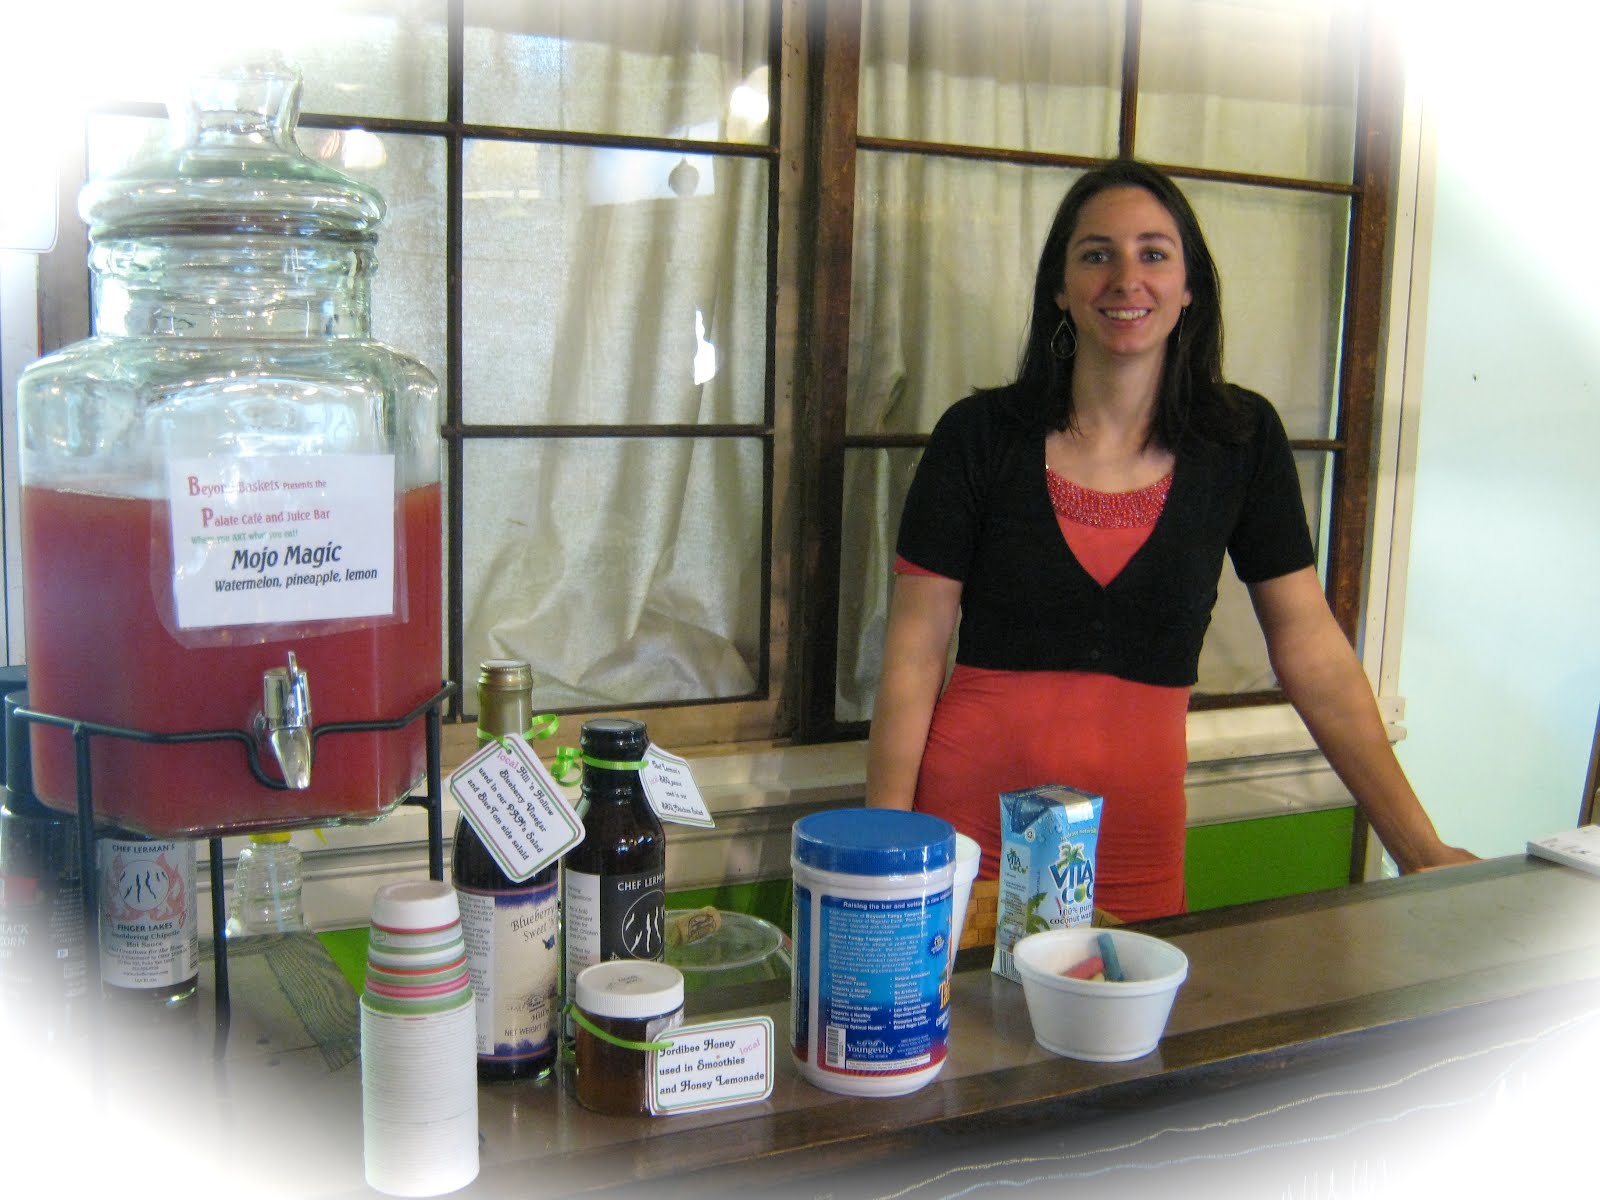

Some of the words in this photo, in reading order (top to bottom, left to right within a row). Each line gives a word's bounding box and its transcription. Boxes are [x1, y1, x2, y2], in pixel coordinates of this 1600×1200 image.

[187, 475, 236, 498] Beyon
[238, 479, 280, 494] Baskets
[282, 481, 314, 491] Presents
[315, 479, 327, 489] the
[201, 507, 239, 529] Palate
[241, 512, 263, 526] Café
[265, 511, 284, 523] and
[287, 510, 311, 523] Juice
[313, 509, 331, 520] Bar
[231, 546, 278, 572] Mojo
[283, 541, 342, 568] Magic
[214, 575, 282, 592] Watermelon,
[285, 570, 341, 588] pineapple,
[345, 568, 378, 581] lemon
[497, 751, 519, 769] local
[467, 779, 480, 793] and
[501, 825, 513, 840] side
[478, 767, 492, 781] used
[490, 782, 498, 793] in
[496, 792, 507, 805] our
[526, 831, 544, 854] Salad
[499, 769, 525, 804] Blueberry
[526, 802, 547, 833] Vinegar
[533, 789, 555, 816] Hollow
[112, 844, 131, 853] CHEF
[1048, 859, 1094, 889] VITA
[617, 881, 642, 891] CHEF
[843, 901, 867, 910] Raising
[117, 923, 146, 932] FINGER
[148, 922, 173, 932] LAKES
[511, 905, 555, 932] Blueberry
[523, 923, 547, 942] Sweet
[504, 1028, 517, 1037] NET
[519, 1023, 542, 1035] WEIGHT
[703, 1038, 736, 1052] Honey
[740, 1038, 761, 1055] local
[846, 1043, 895, 1055] Youngevity
[659, 1064, 681, 1075] used
[684, 1063, 693, 1072] in
[696, 1056, 746, 1071] Smoothies
[660, 1084, 677, 1095] and
[680, 1080, 713, 1093] Honey
[715, 1072, 765, 1086] Lemonade
